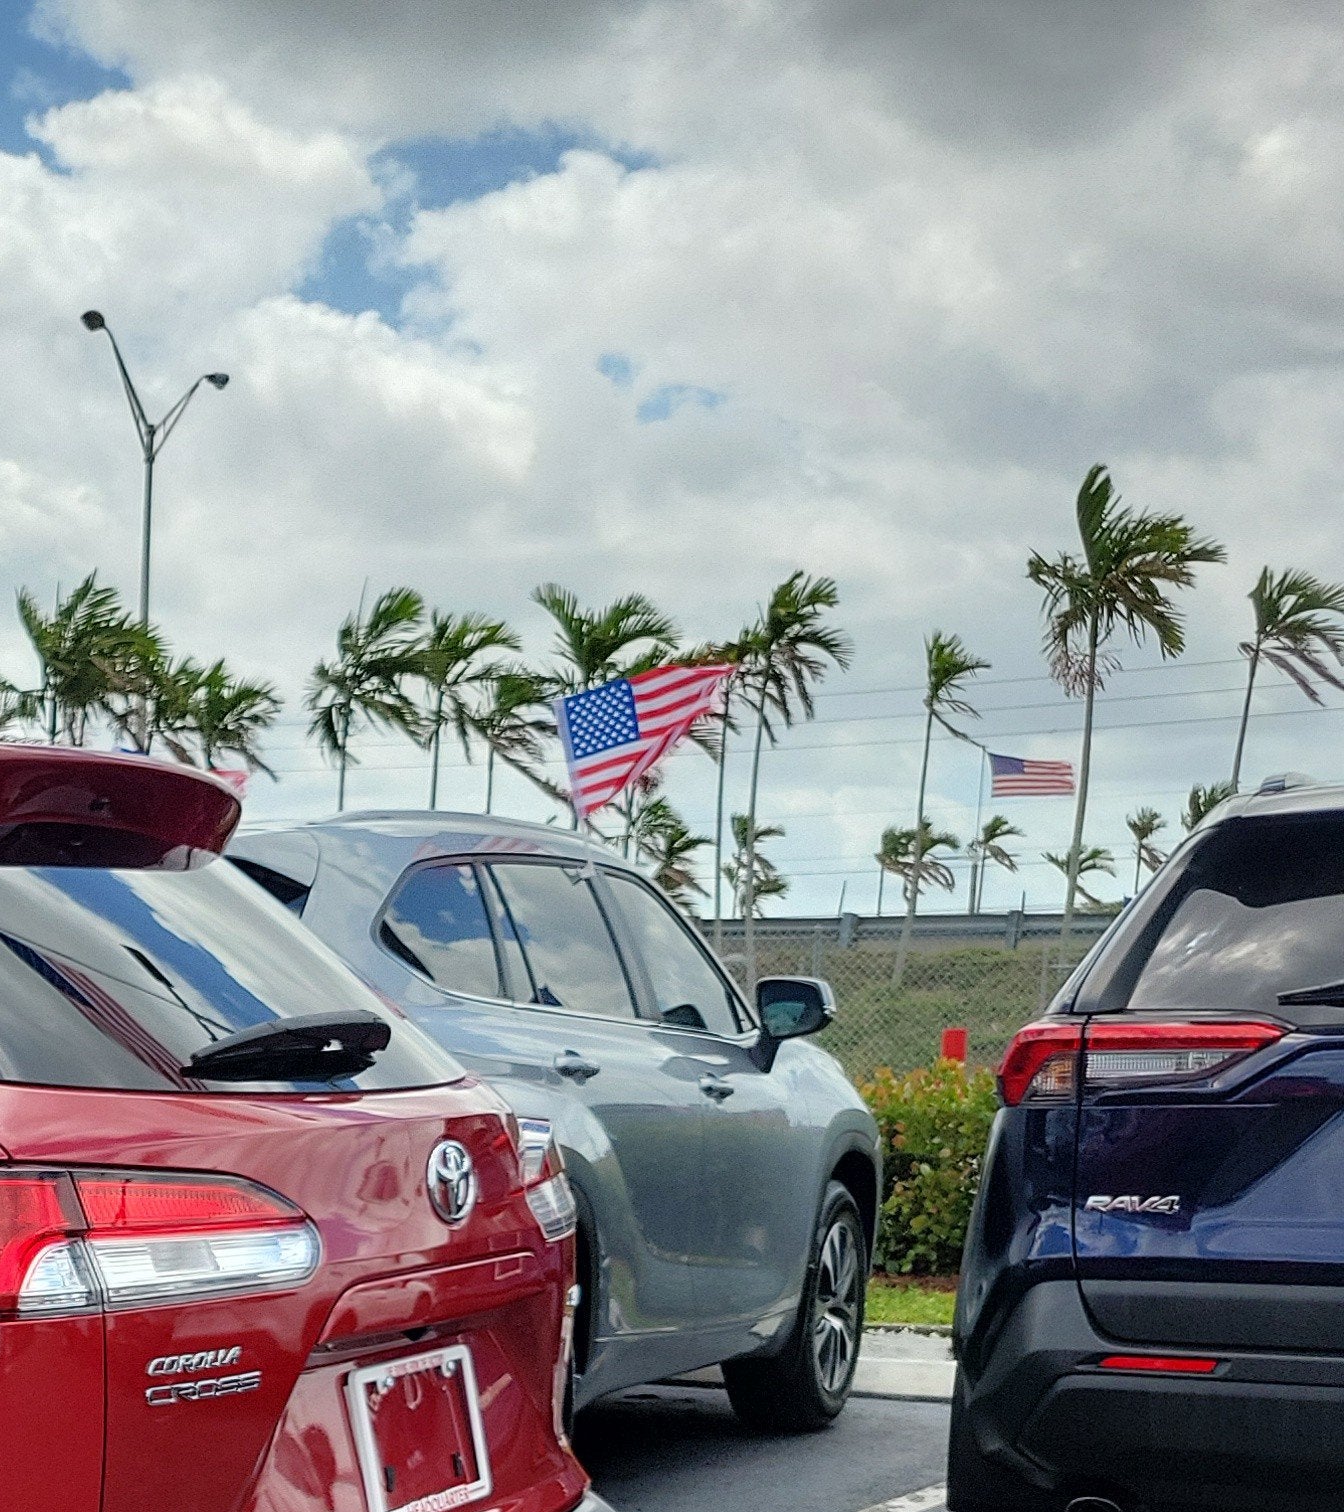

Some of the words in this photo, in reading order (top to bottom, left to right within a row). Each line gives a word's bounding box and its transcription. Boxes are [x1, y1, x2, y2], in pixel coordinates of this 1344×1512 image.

[1084, 1195, 1180, 1215] RAV4
[146, 1346, 242, 1376] COROLLA
[145, 1370, 262, 1405] CROSS
